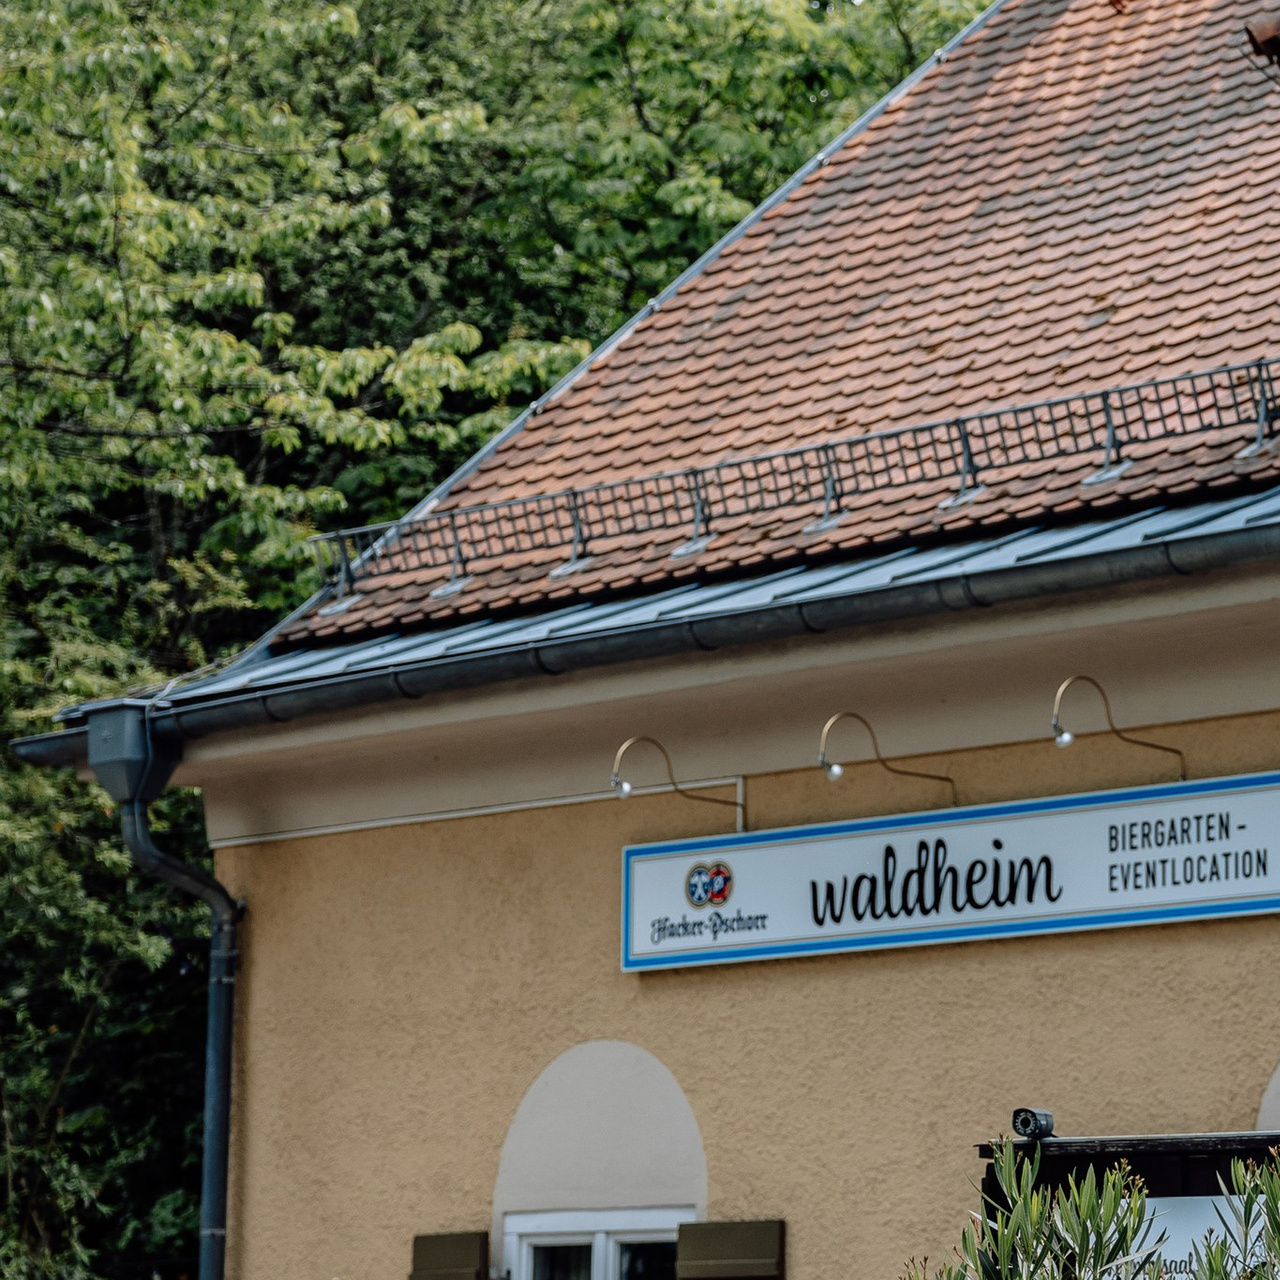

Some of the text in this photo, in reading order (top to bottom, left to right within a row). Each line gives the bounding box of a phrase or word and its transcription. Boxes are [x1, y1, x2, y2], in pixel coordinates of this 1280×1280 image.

[1108, 812, 1230, 852] BIERGARTEN
[811, 839, 1063, 927] waldheim
[1108, 849, 1268, 892] EVENTLOCATION
[651, 908, 768, 945] Hacker-Pschorr
